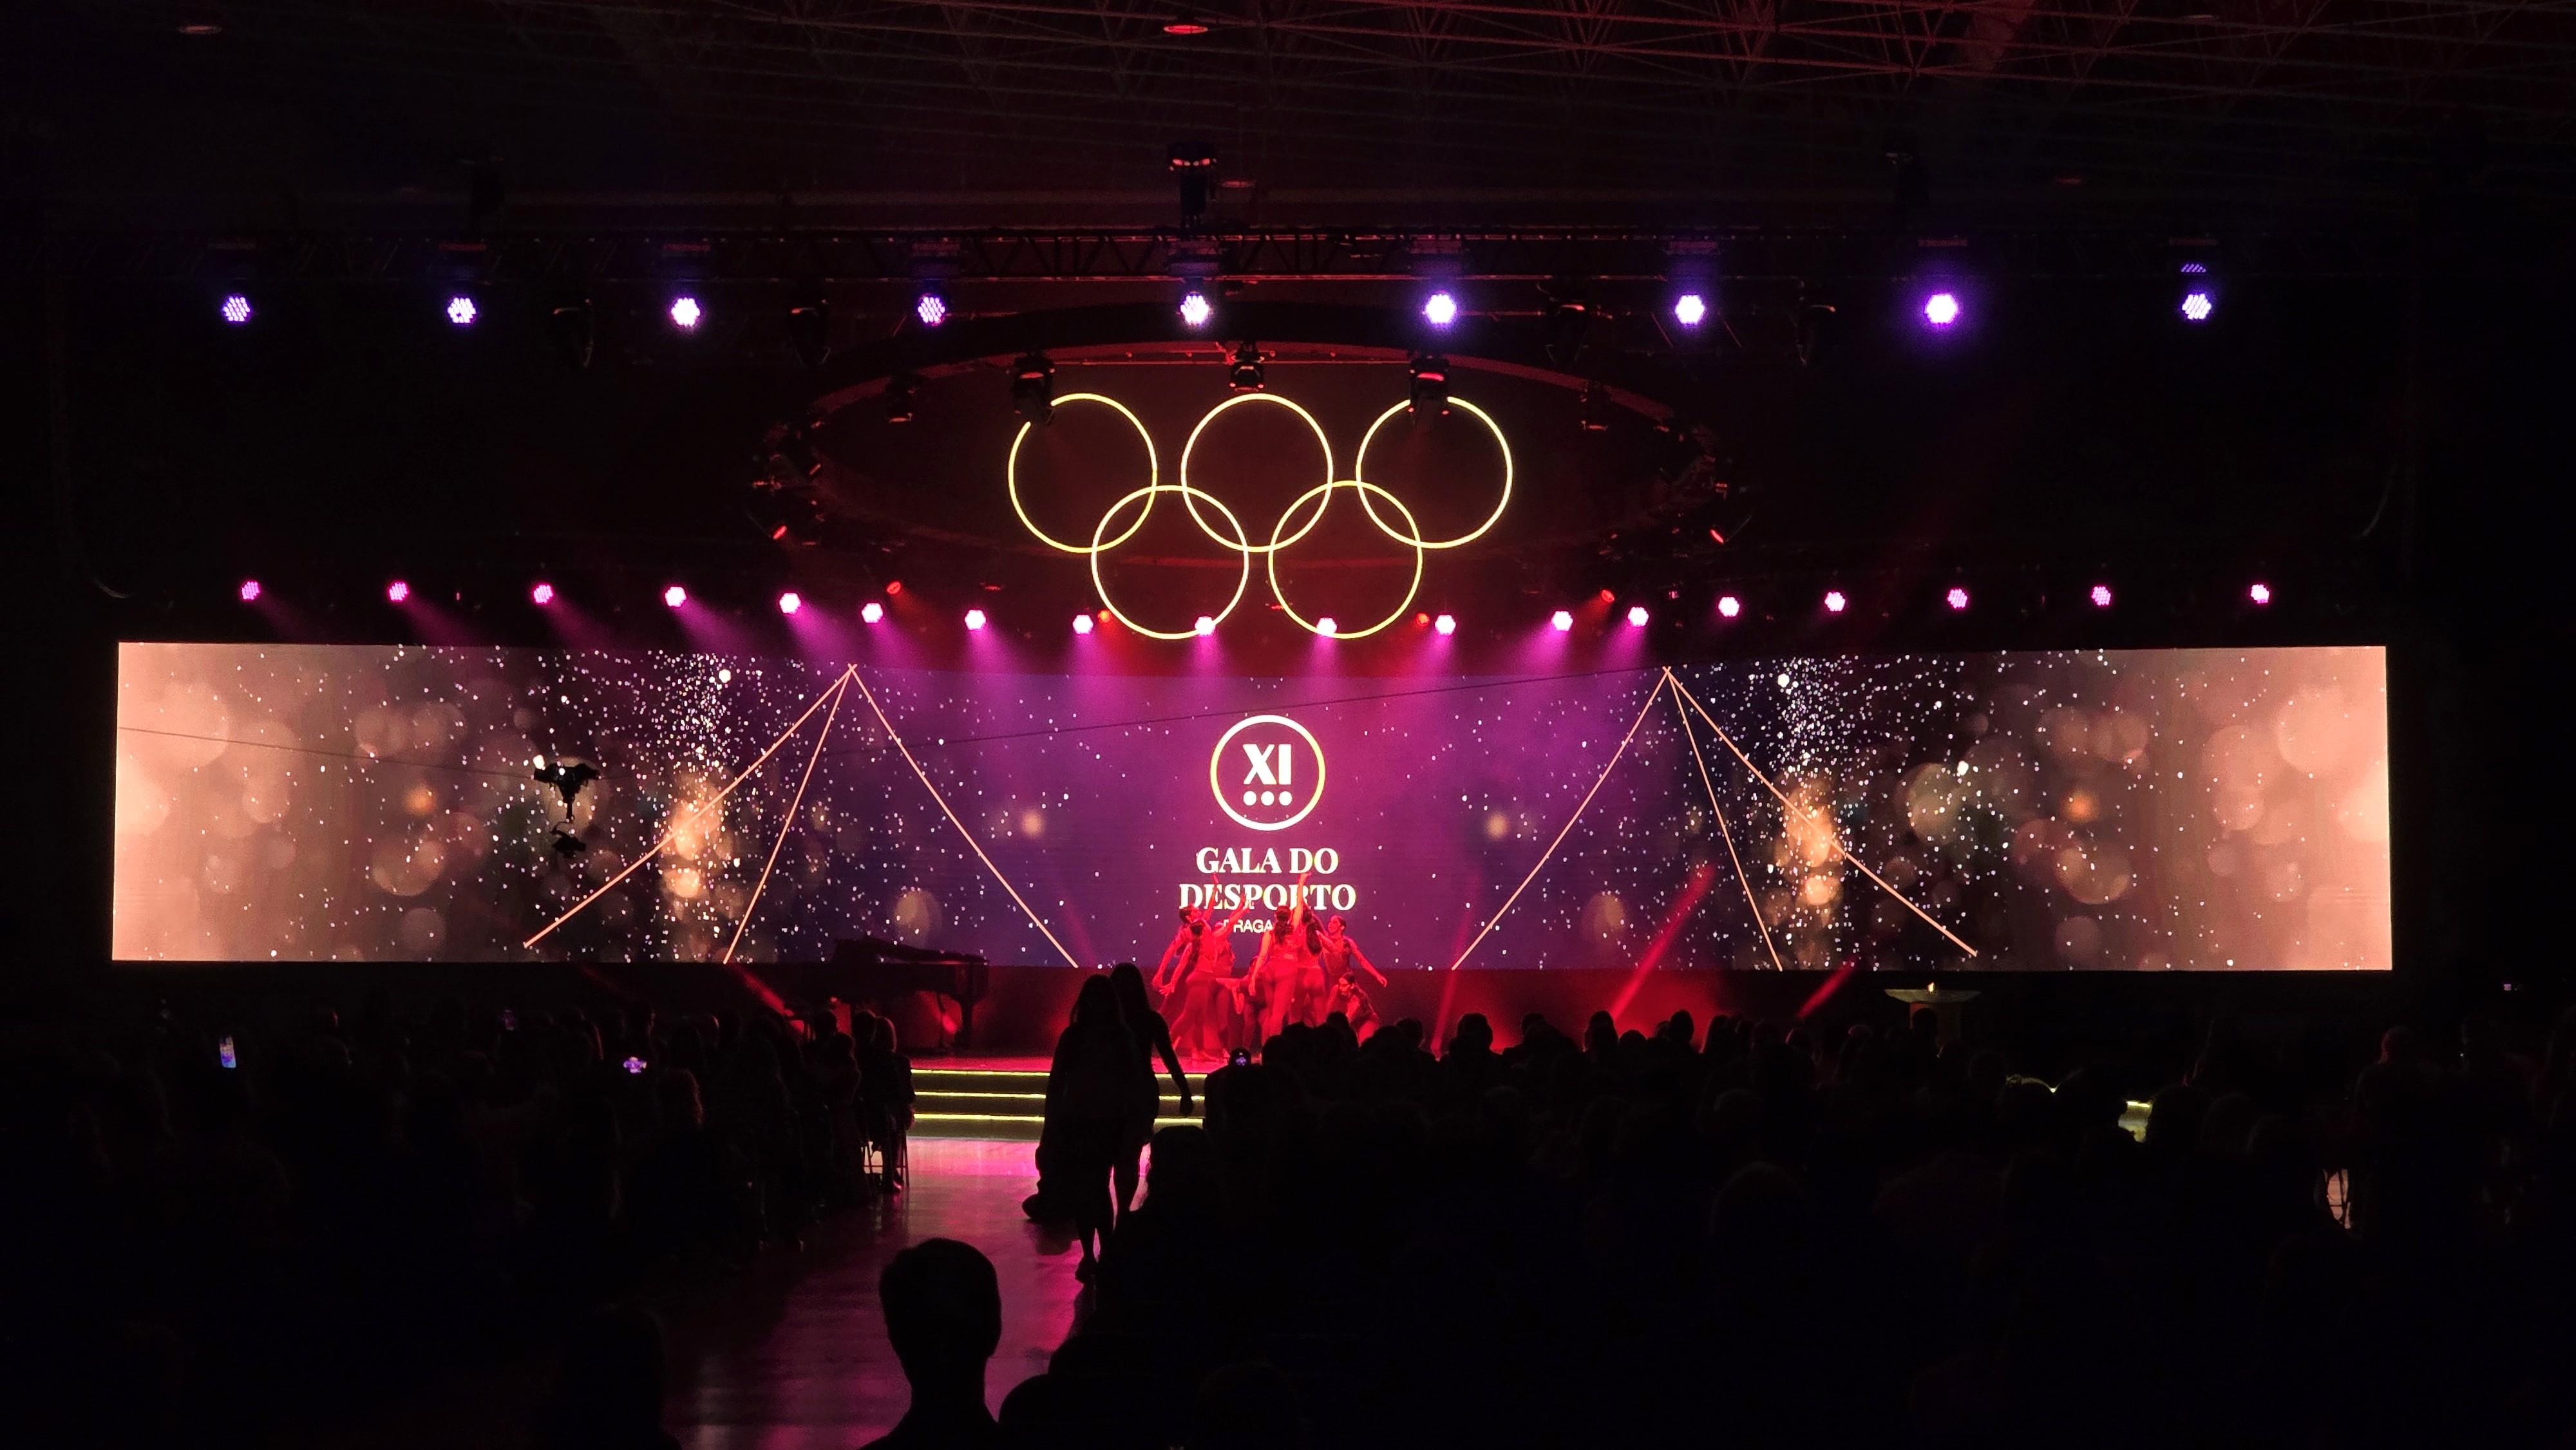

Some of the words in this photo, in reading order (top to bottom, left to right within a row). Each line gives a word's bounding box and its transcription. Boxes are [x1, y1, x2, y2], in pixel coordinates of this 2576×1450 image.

[1242, 744, 1292, 785] XI
[1196, 847, 1282, 874] GALA
[1289, 847, 1339, 874] DO
